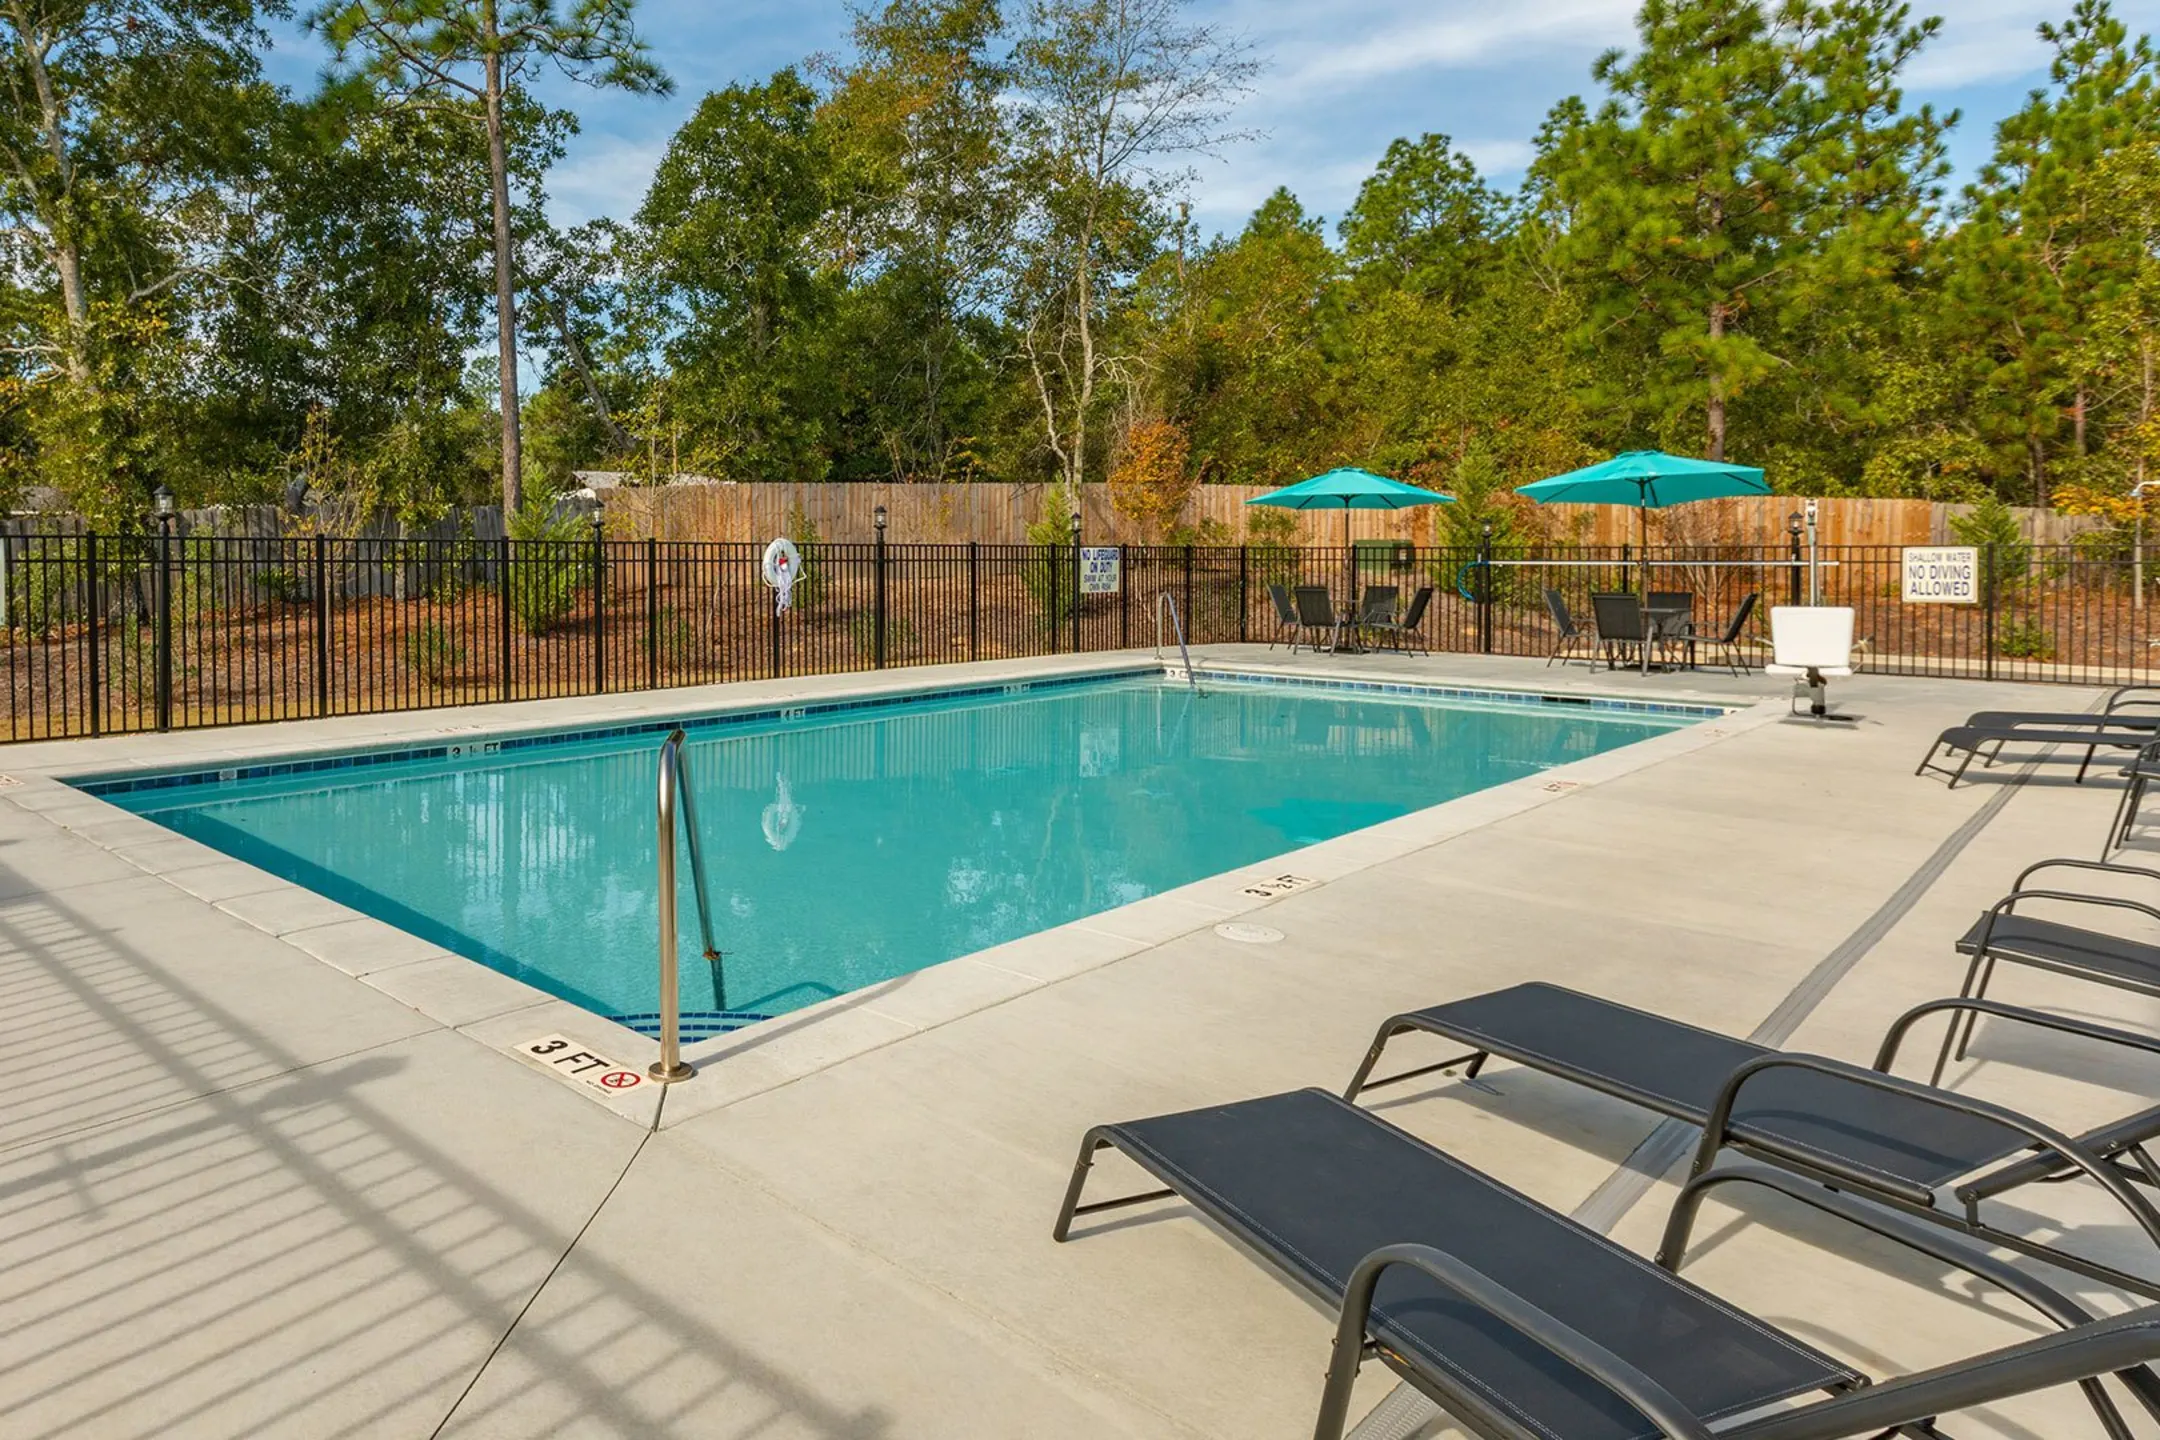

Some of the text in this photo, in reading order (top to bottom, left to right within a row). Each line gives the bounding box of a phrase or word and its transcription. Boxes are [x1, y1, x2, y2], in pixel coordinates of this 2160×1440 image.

[1909, 565, 1971, 579] NO DIVING
[1910, 581, 1969, 596] ALLOWED
[531, 1040, 611, 1074] 3 FT
